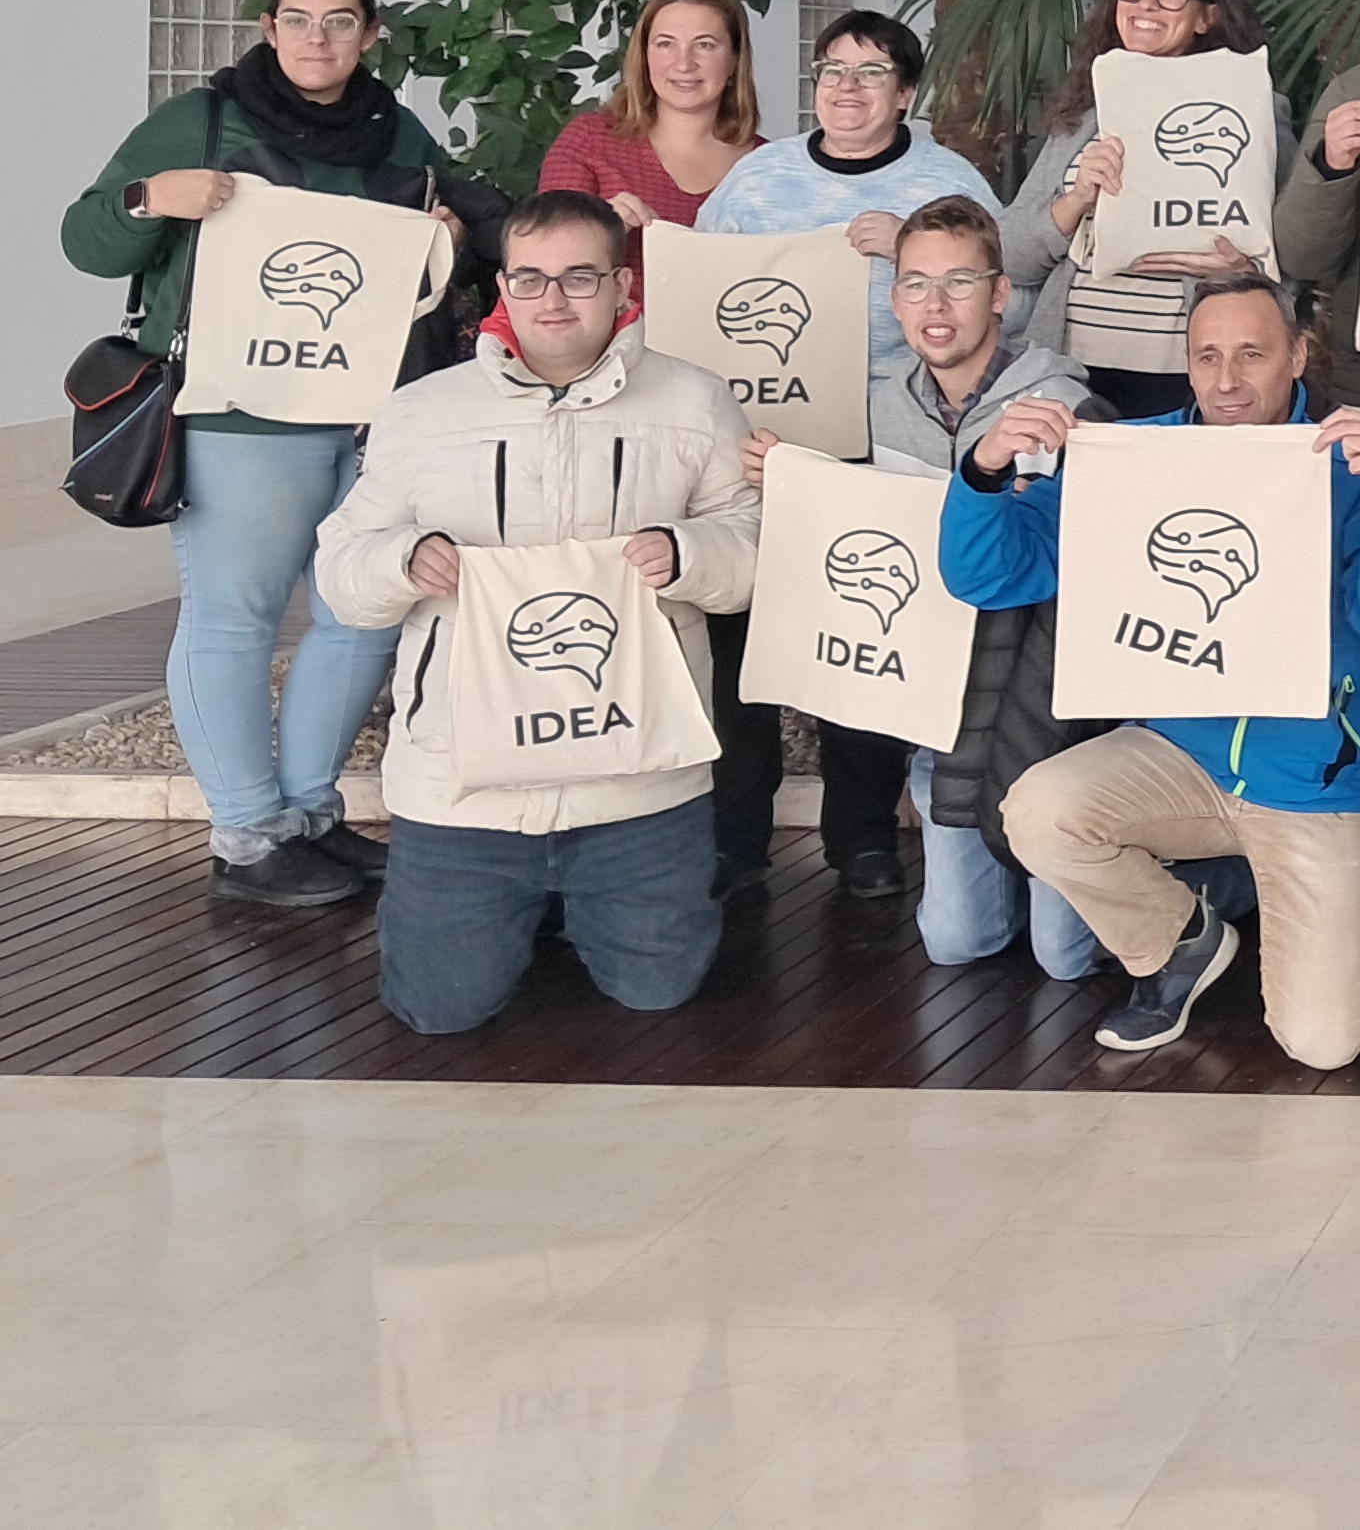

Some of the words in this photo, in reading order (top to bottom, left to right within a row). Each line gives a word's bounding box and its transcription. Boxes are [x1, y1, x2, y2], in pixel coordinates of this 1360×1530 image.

[1153, 199, 1250, 228] IDEA
[246, 338, 350, 371] IDEA
[727, 376, 811, 404] DEA
[816, 631, 906, 682] IDEA
[1113, 612, 1225, 675] IDEA
[514, 701, 634, 747] IDEA
